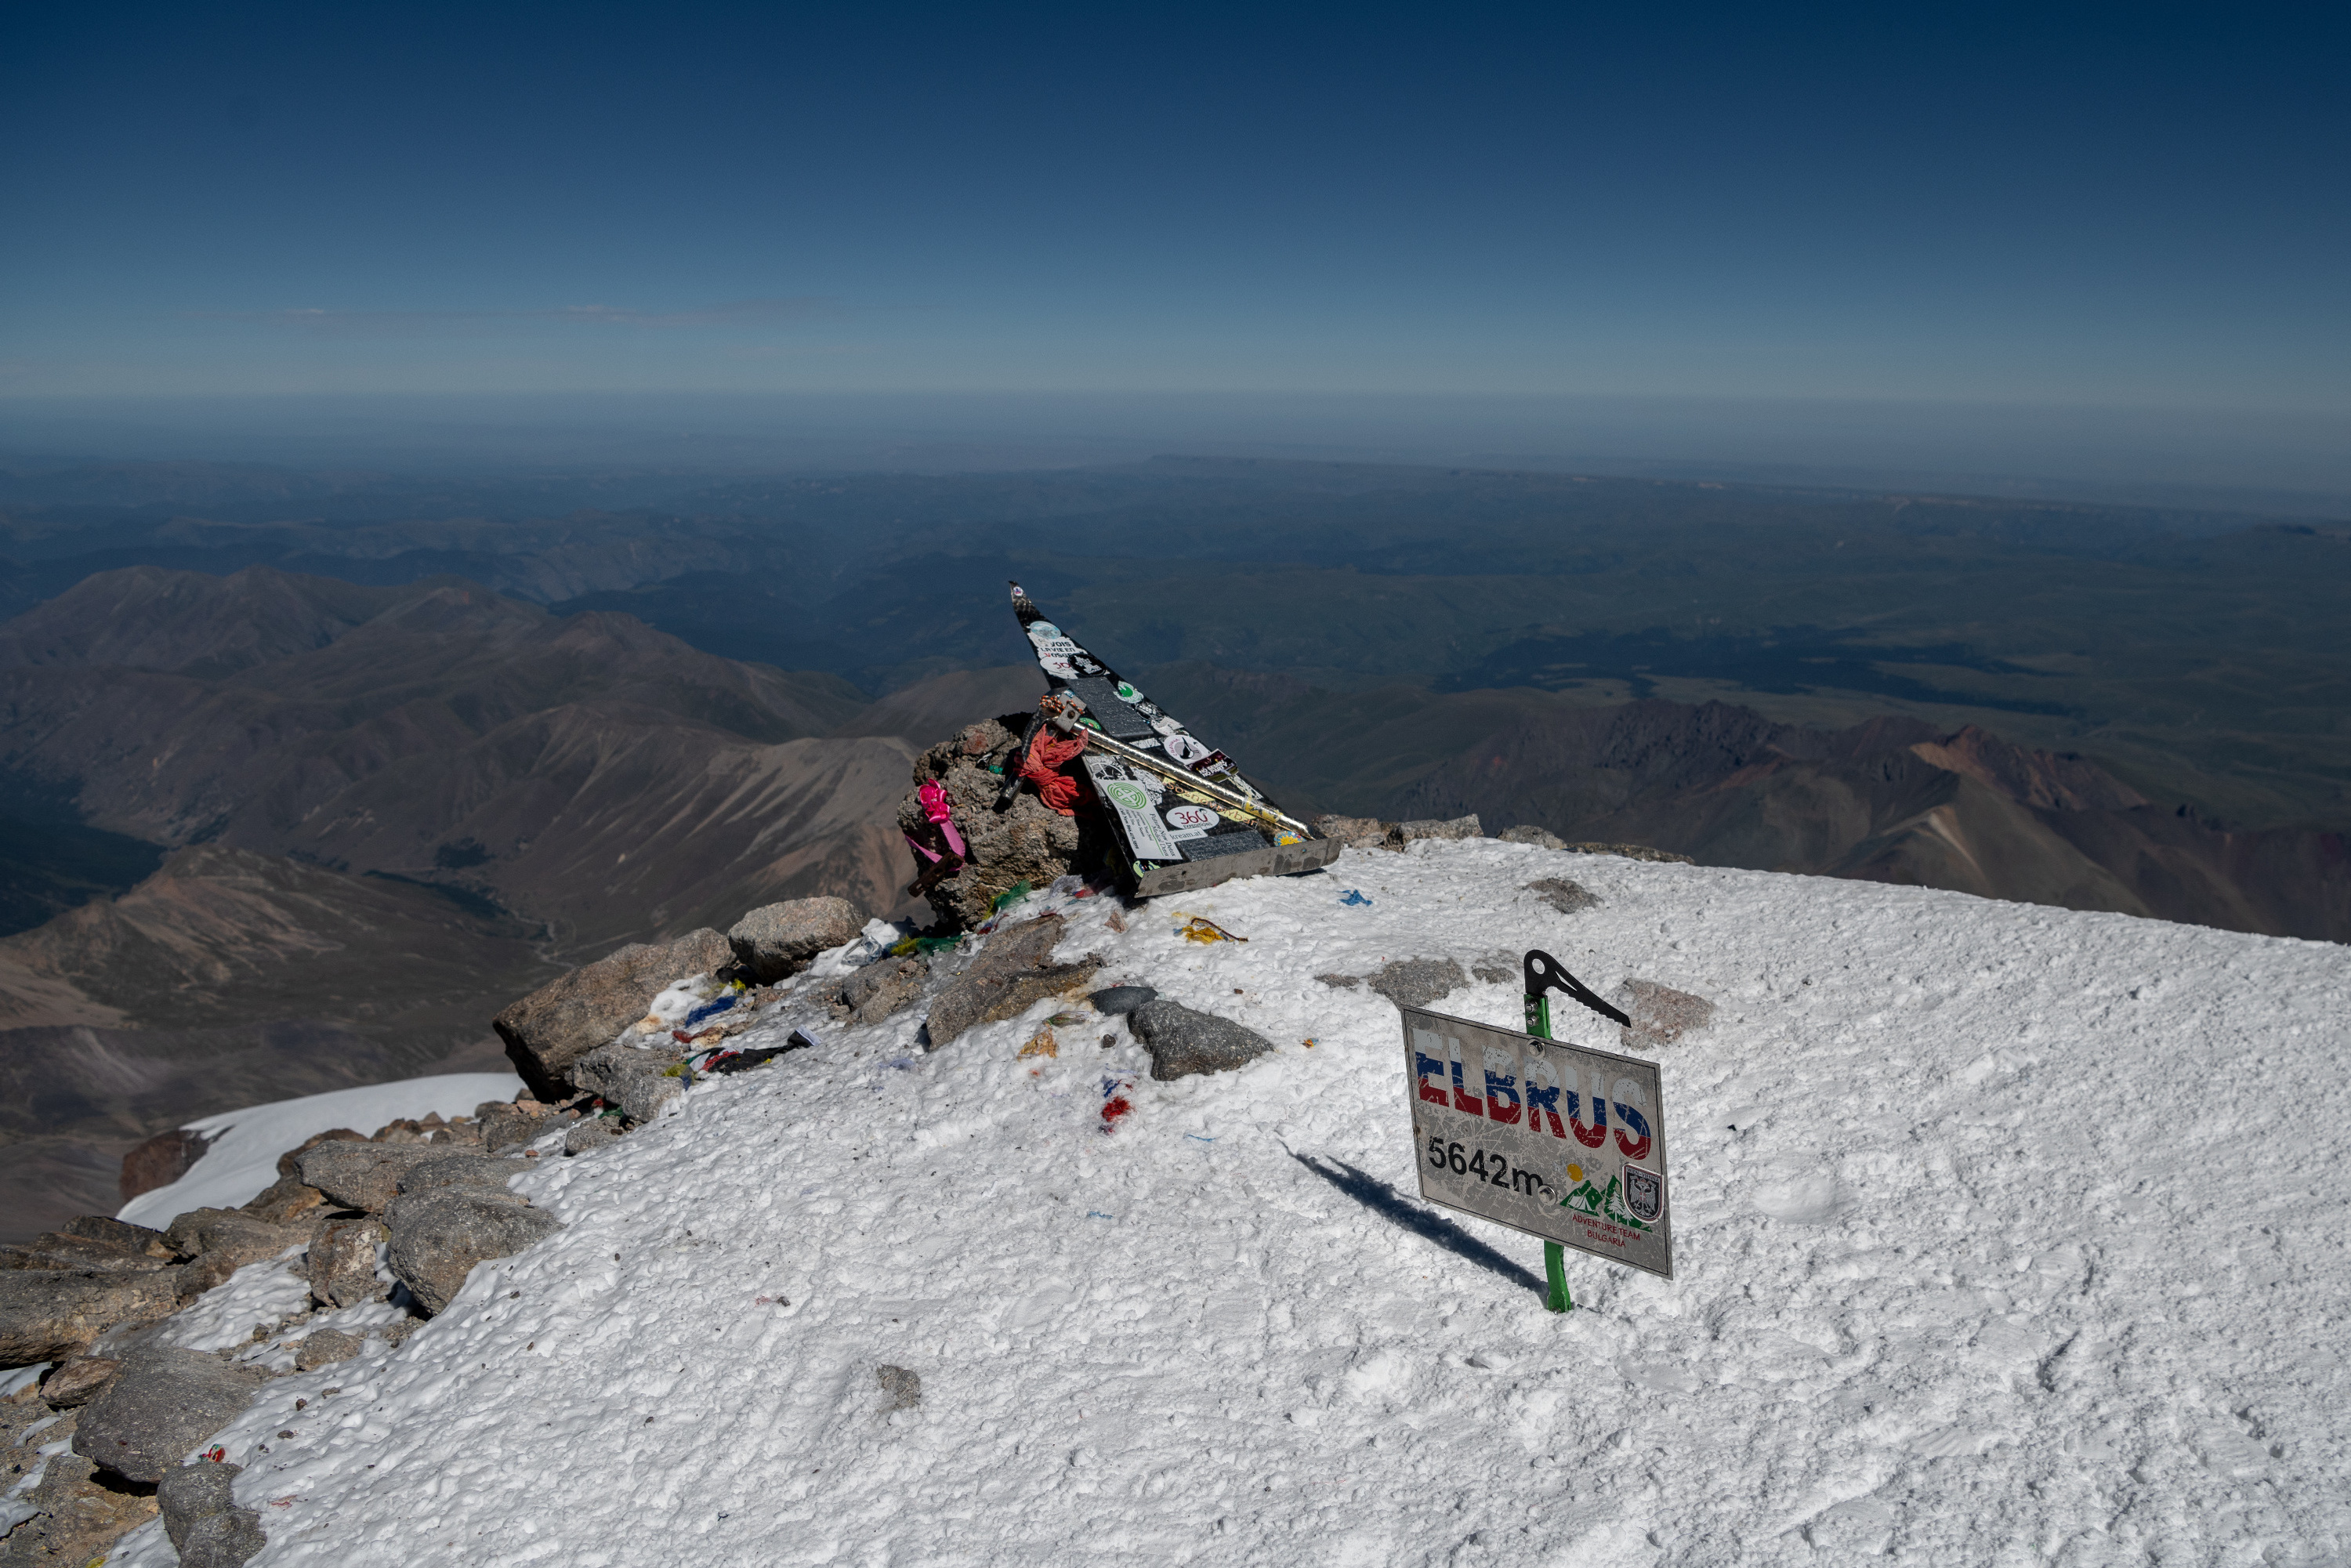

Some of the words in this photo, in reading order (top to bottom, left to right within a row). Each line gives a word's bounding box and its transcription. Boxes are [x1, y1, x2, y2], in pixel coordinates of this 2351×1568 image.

[1211, 762, 1228, 775] PARTY
[1175, 811, 1208, 824] 360
[1150, 813, 1161, 830] Future
[1159, 829, 1168, 841] Now
[1165, 842, 1176, 856] Detox
[1151, 825, 1163, 842] Medical
[1160, 842, 1168, 856] Detox
[1169, 831, 1202, 840] kream.at
[1413, 1029, 1651, 1160] ELBRUS
[1429, 1135, 1544, 1196] 5642m
[1572, 1214, 1617, 1234] ADVENTURE
[1618, 1227, 1640, 1240] TEAM
[1587, 1229, 1627, 1248] BULGARIA
